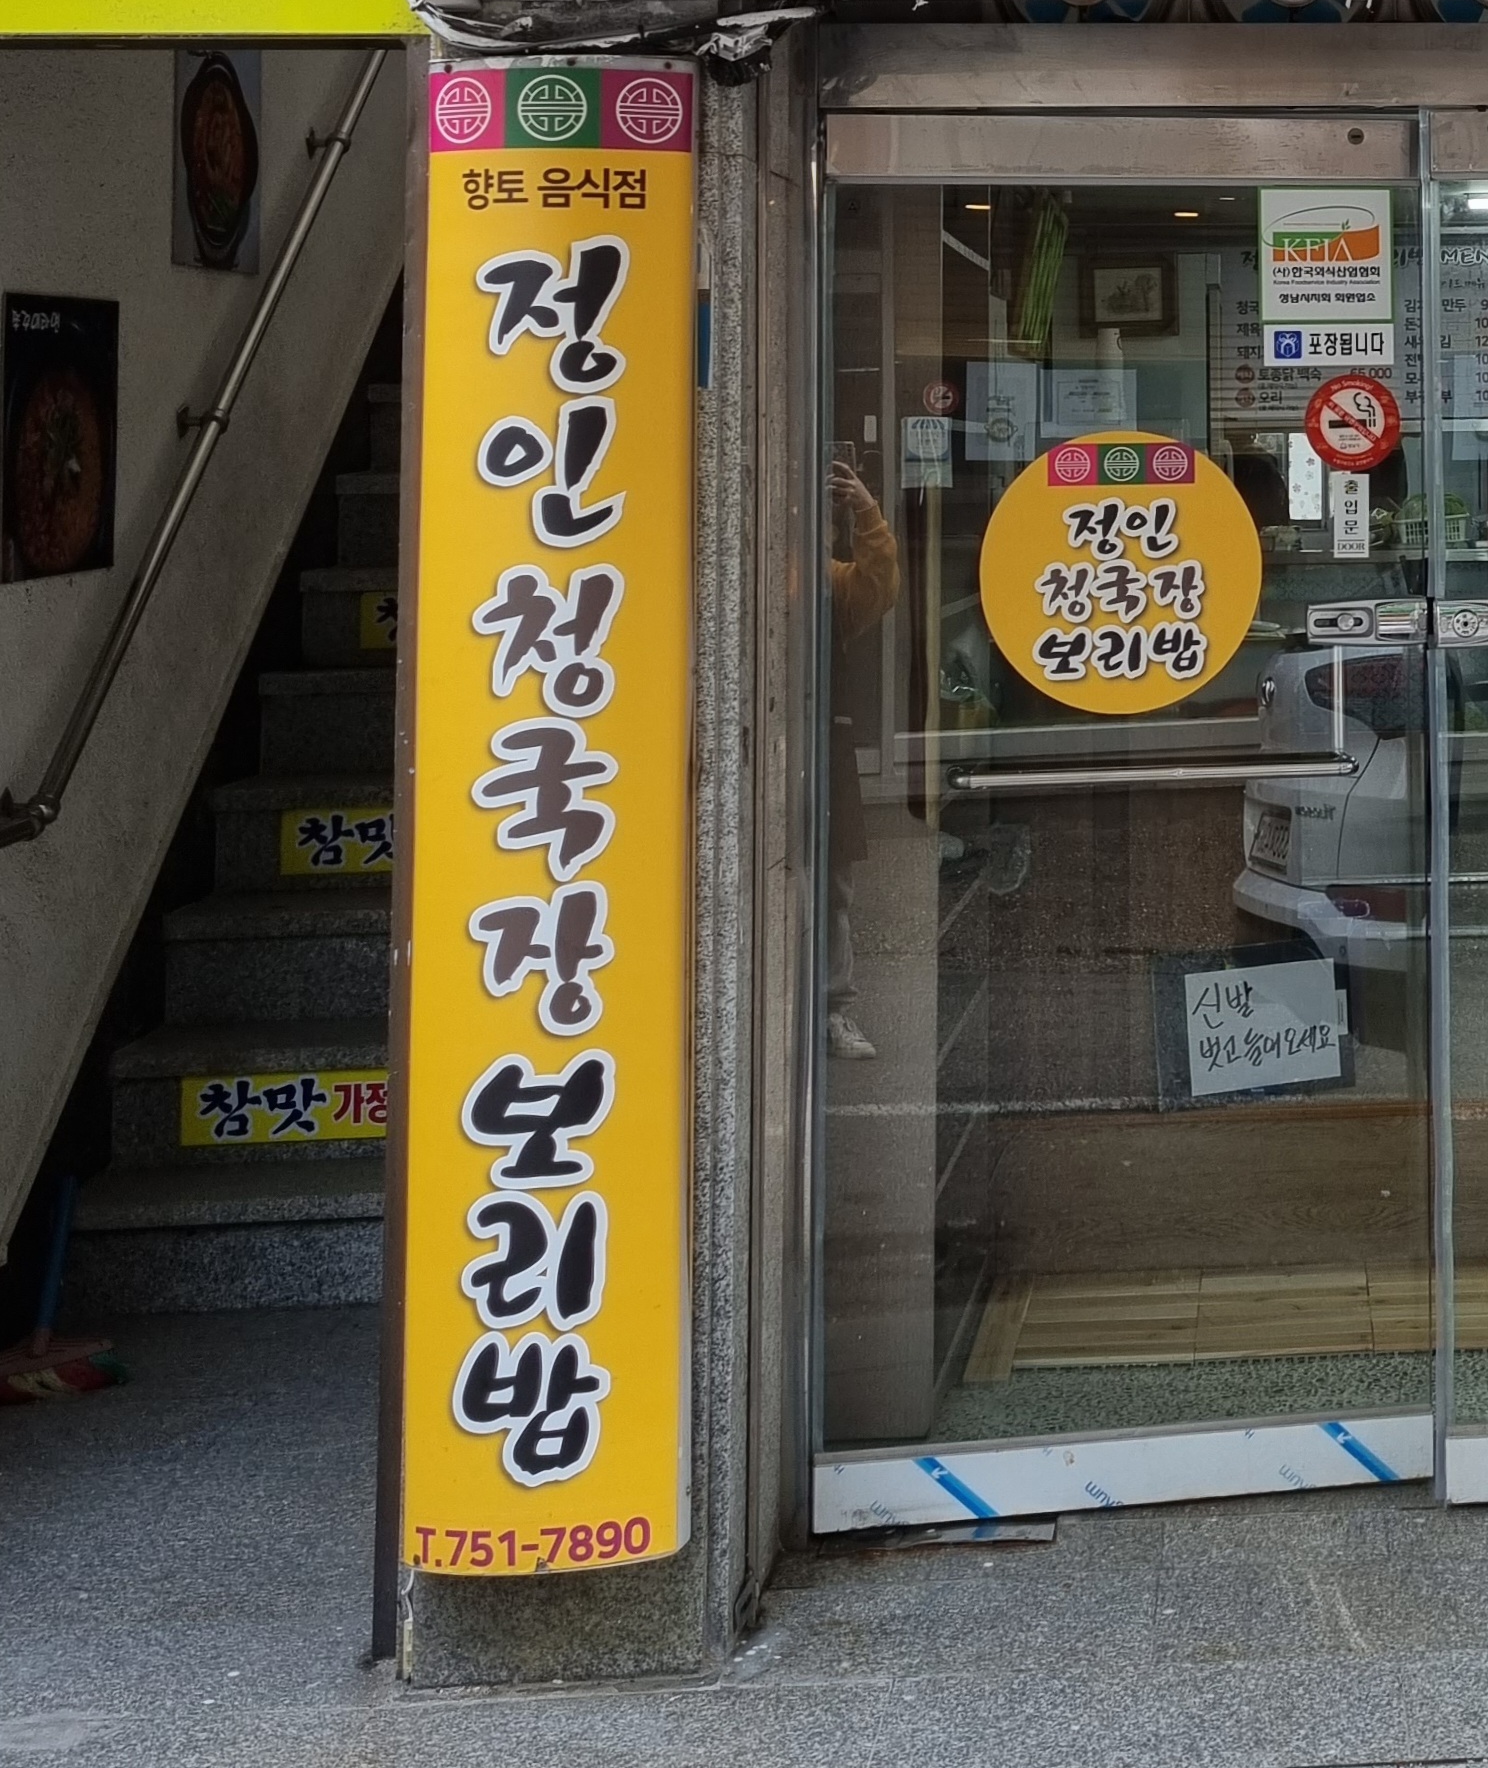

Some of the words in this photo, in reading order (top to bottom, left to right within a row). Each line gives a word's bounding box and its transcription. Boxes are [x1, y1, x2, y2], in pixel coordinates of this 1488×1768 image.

[461, 169, 529, 211] 향토
[537, 168, 648, 211] 음식점
[1308, 332, 1385, 356] 포장됩니다
[1258, 390, 1283, 405] 오리
[1063, 497, 1179, 559] 정인
[1343, 479, 1360, 535] 출입문
[1336, 542, 1366, 551] DOOR
[1035, 557, 1206, 622] 청국장
[1030, 622, 1207, 682] 보리밥
[1192, 980, 1255, 1030] 신발
[200, 1078, 327, 1139] 참맛
[414, 1515, 652, 1569] T.751-7890
